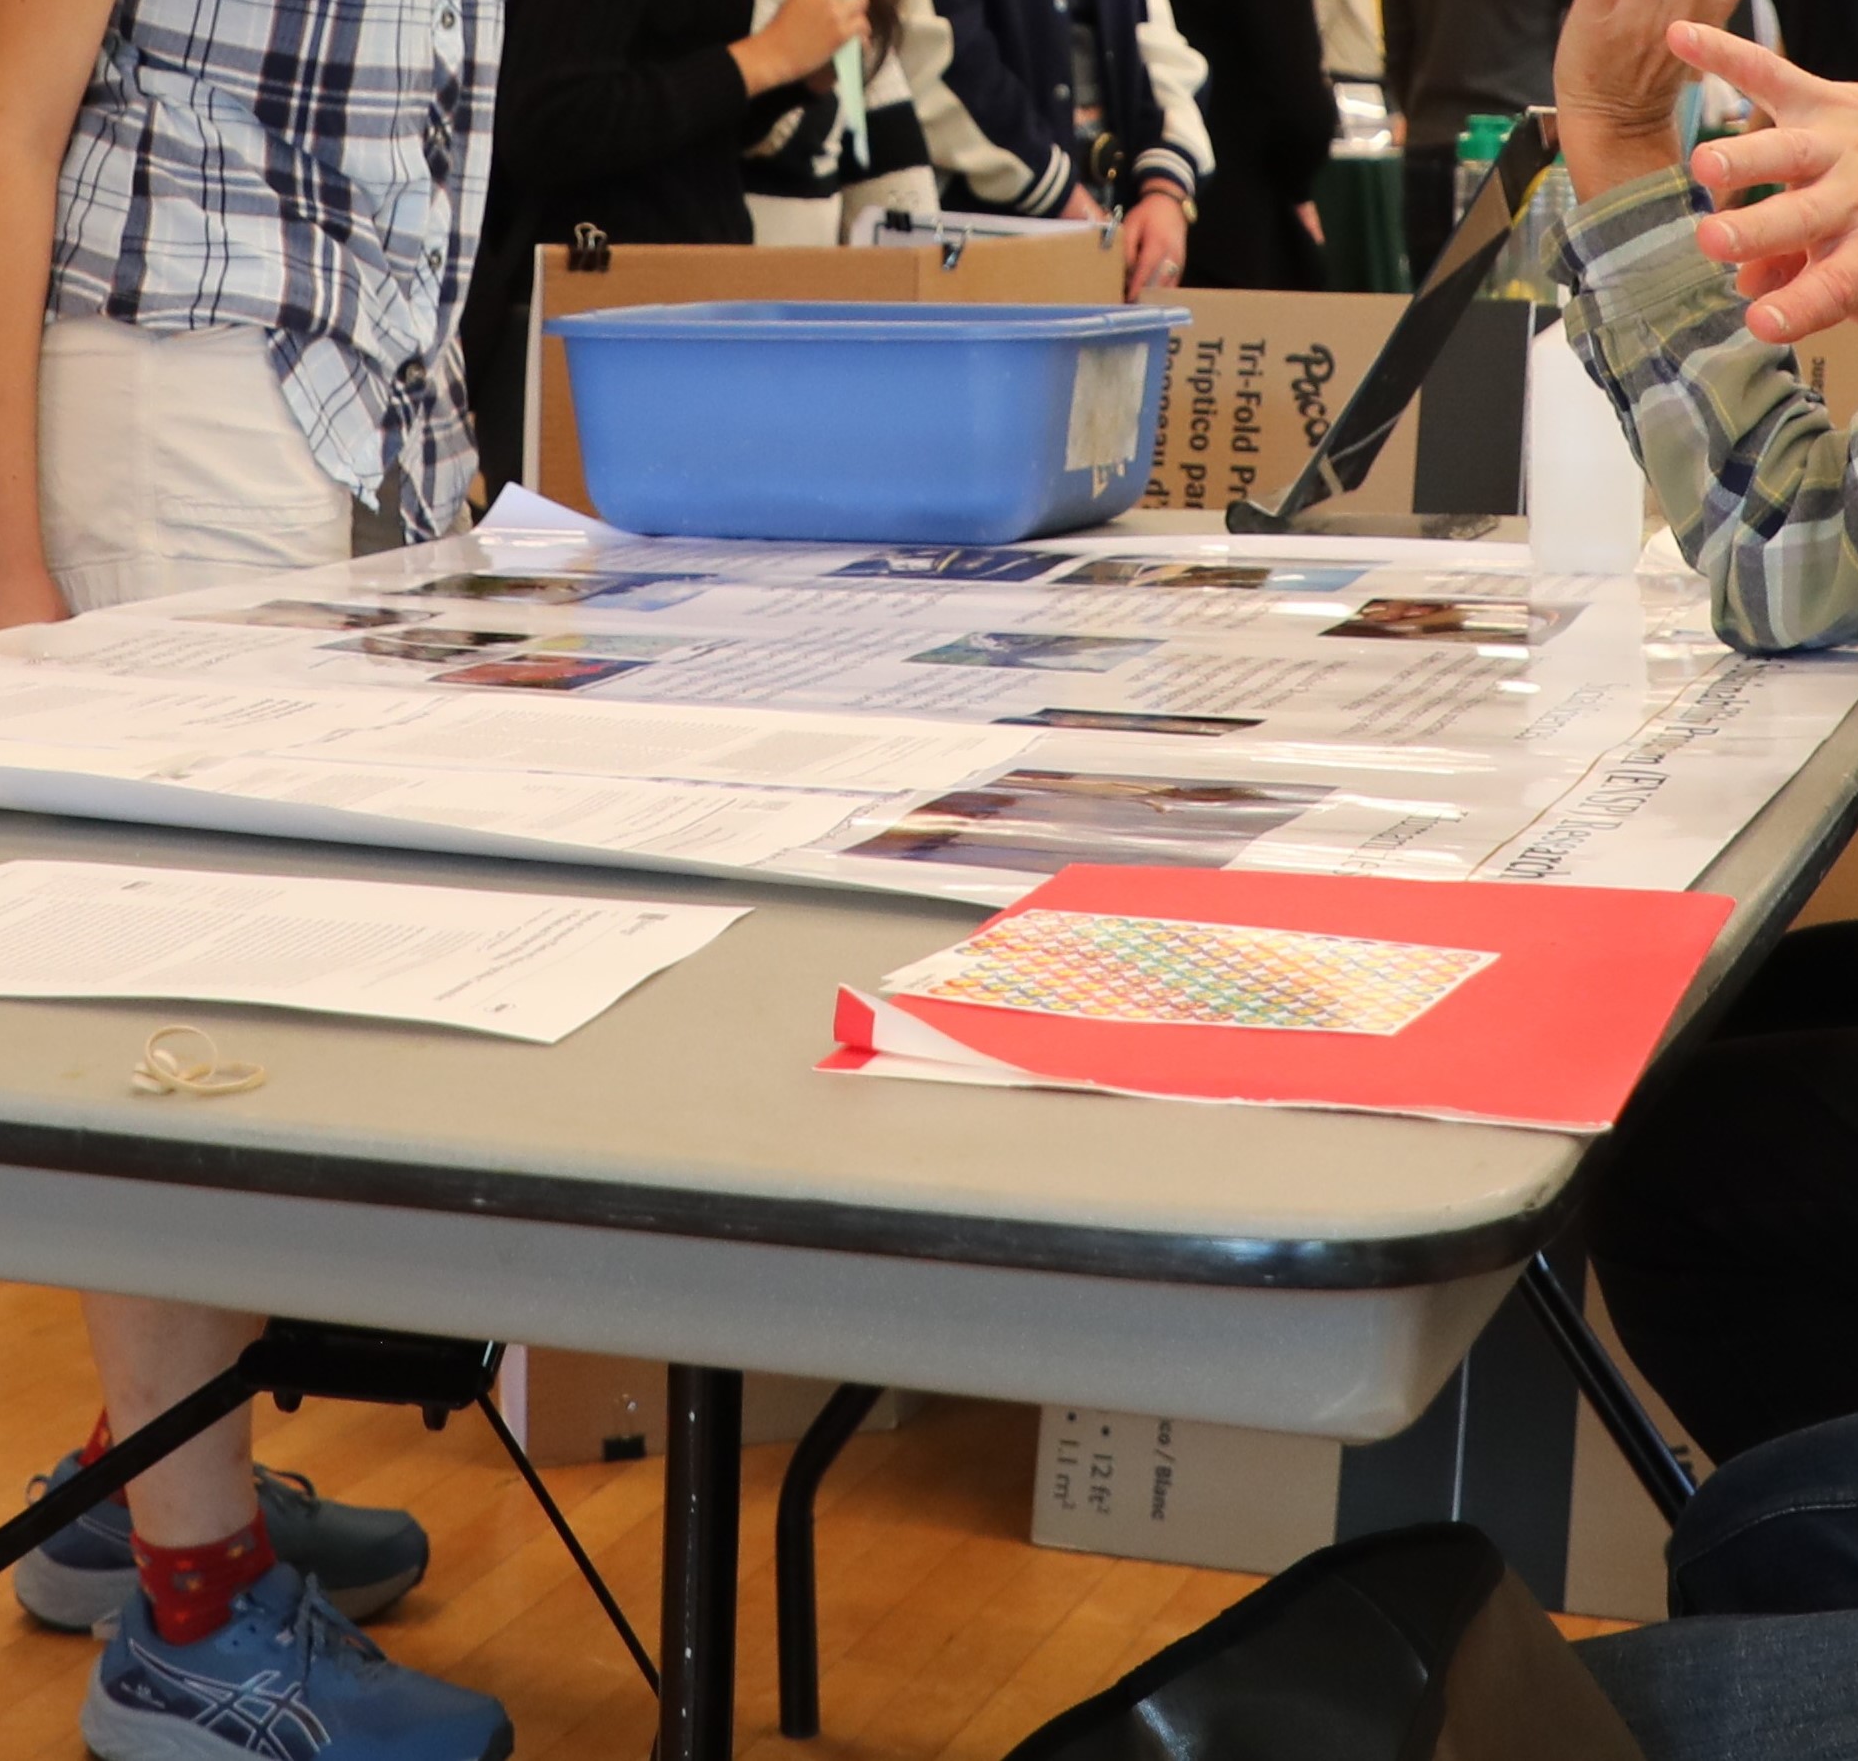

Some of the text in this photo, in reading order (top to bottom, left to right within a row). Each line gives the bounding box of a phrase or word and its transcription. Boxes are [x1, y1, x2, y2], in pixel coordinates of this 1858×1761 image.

[1232, 339, 1266, 454] Tri-Fold
[1286, 343, 1335, 448] Paco
[1500, 818, 1624, 879] Research
[1090, 1453, 1113, 1478] 12
